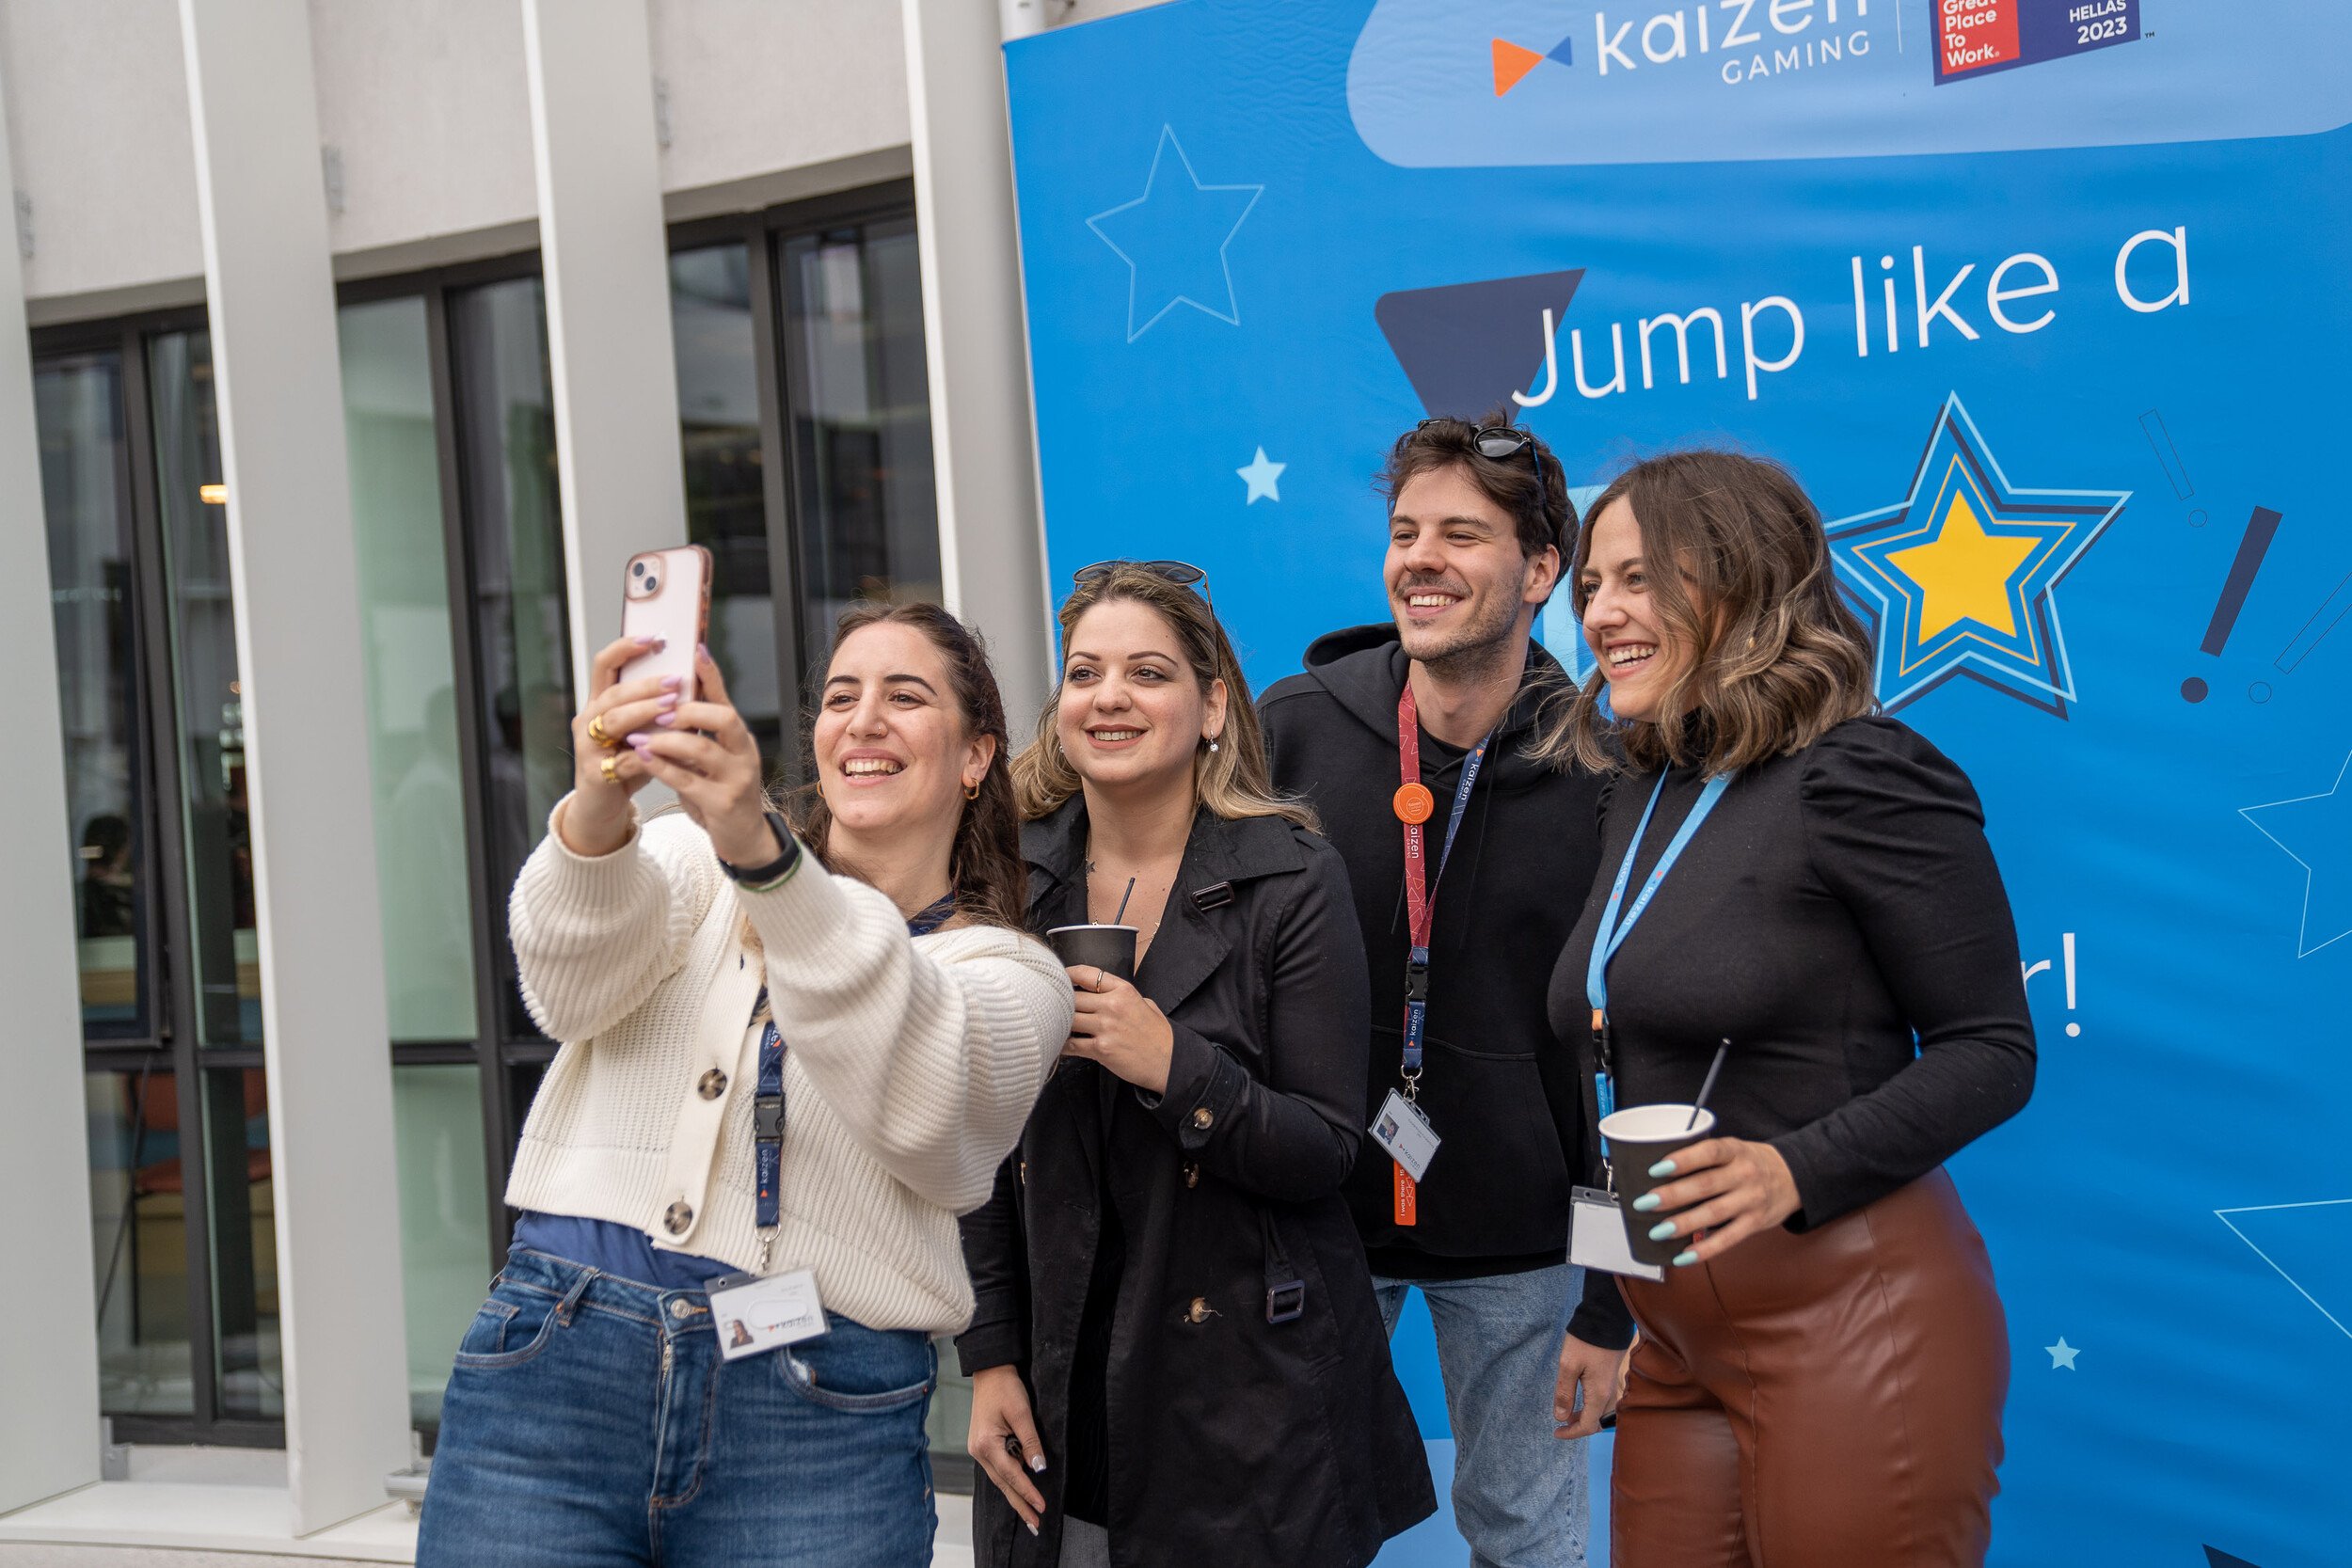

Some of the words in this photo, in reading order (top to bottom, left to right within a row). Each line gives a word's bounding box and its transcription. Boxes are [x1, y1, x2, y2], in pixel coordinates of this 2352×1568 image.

[1943, 0, 1996, 14] Grea
[1945, 9, 1996, 33] Place
[2069, 0, 2127, 23] HELLAS
[1945, 33, 1966, 49] To
[2077, 16, 2127, 44] 2023
[1721, 29, 1870, 85] GAMING
[1512, 295, 1805, 408] Jump
[1851, 245, 2059, 357] like
[2114, 226, 2189, 313] a
[1461, 763, 1479, 800] kaizen
[1409, 1009, 1419, 1037] kaizen
